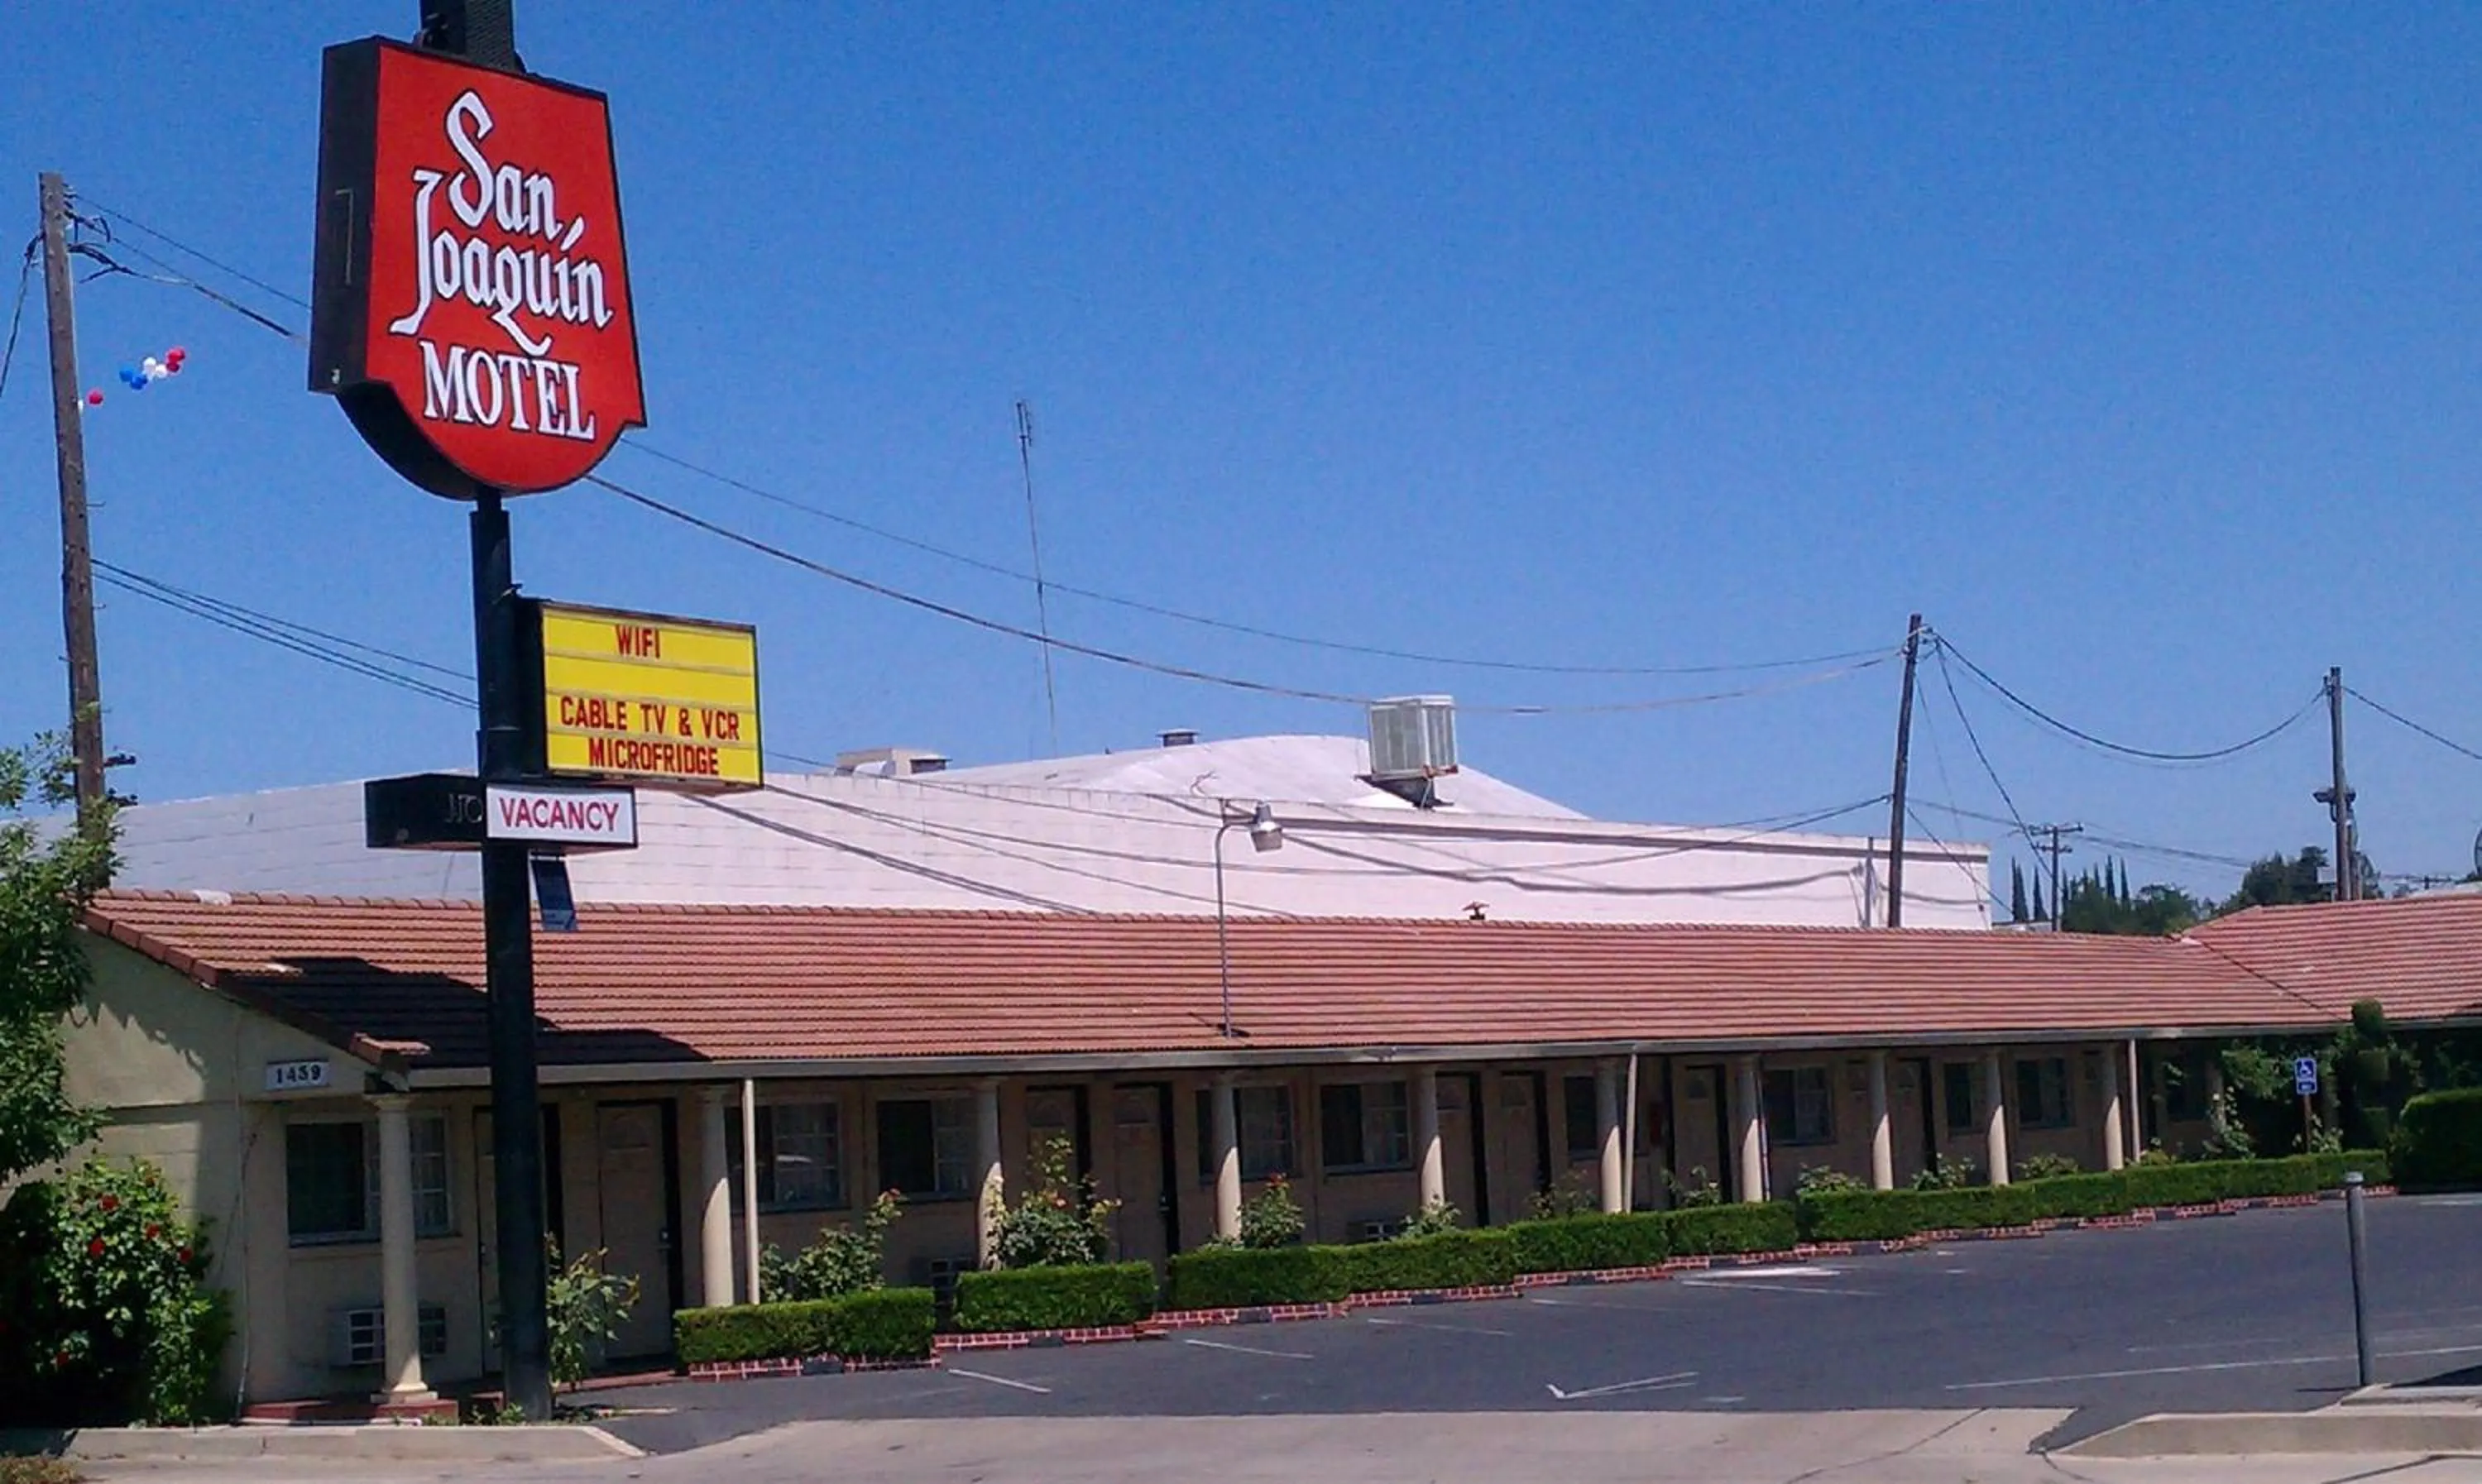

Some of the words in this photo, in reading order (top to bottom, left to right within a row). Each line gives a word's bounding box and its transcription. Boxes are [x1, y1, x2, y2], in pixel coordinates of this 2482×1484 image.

[446, 91, 562, 238] San
[390, 170, 613, 356] Joaquín
[419, 341, 596, 440] MOTEL
[616, 625, 660, 659] WIFI
[560, 696, 627, 730] CABLE
[640, 703, 666, 735] TV
[678, 708, 692, 737] &
[702, 709, 740, 741] VCR
[589, 738, 719, 776] MICROFRIDGE
[500, 797, 619, 831] VACANCY
[277, 1065, 321, 1084] 1459
